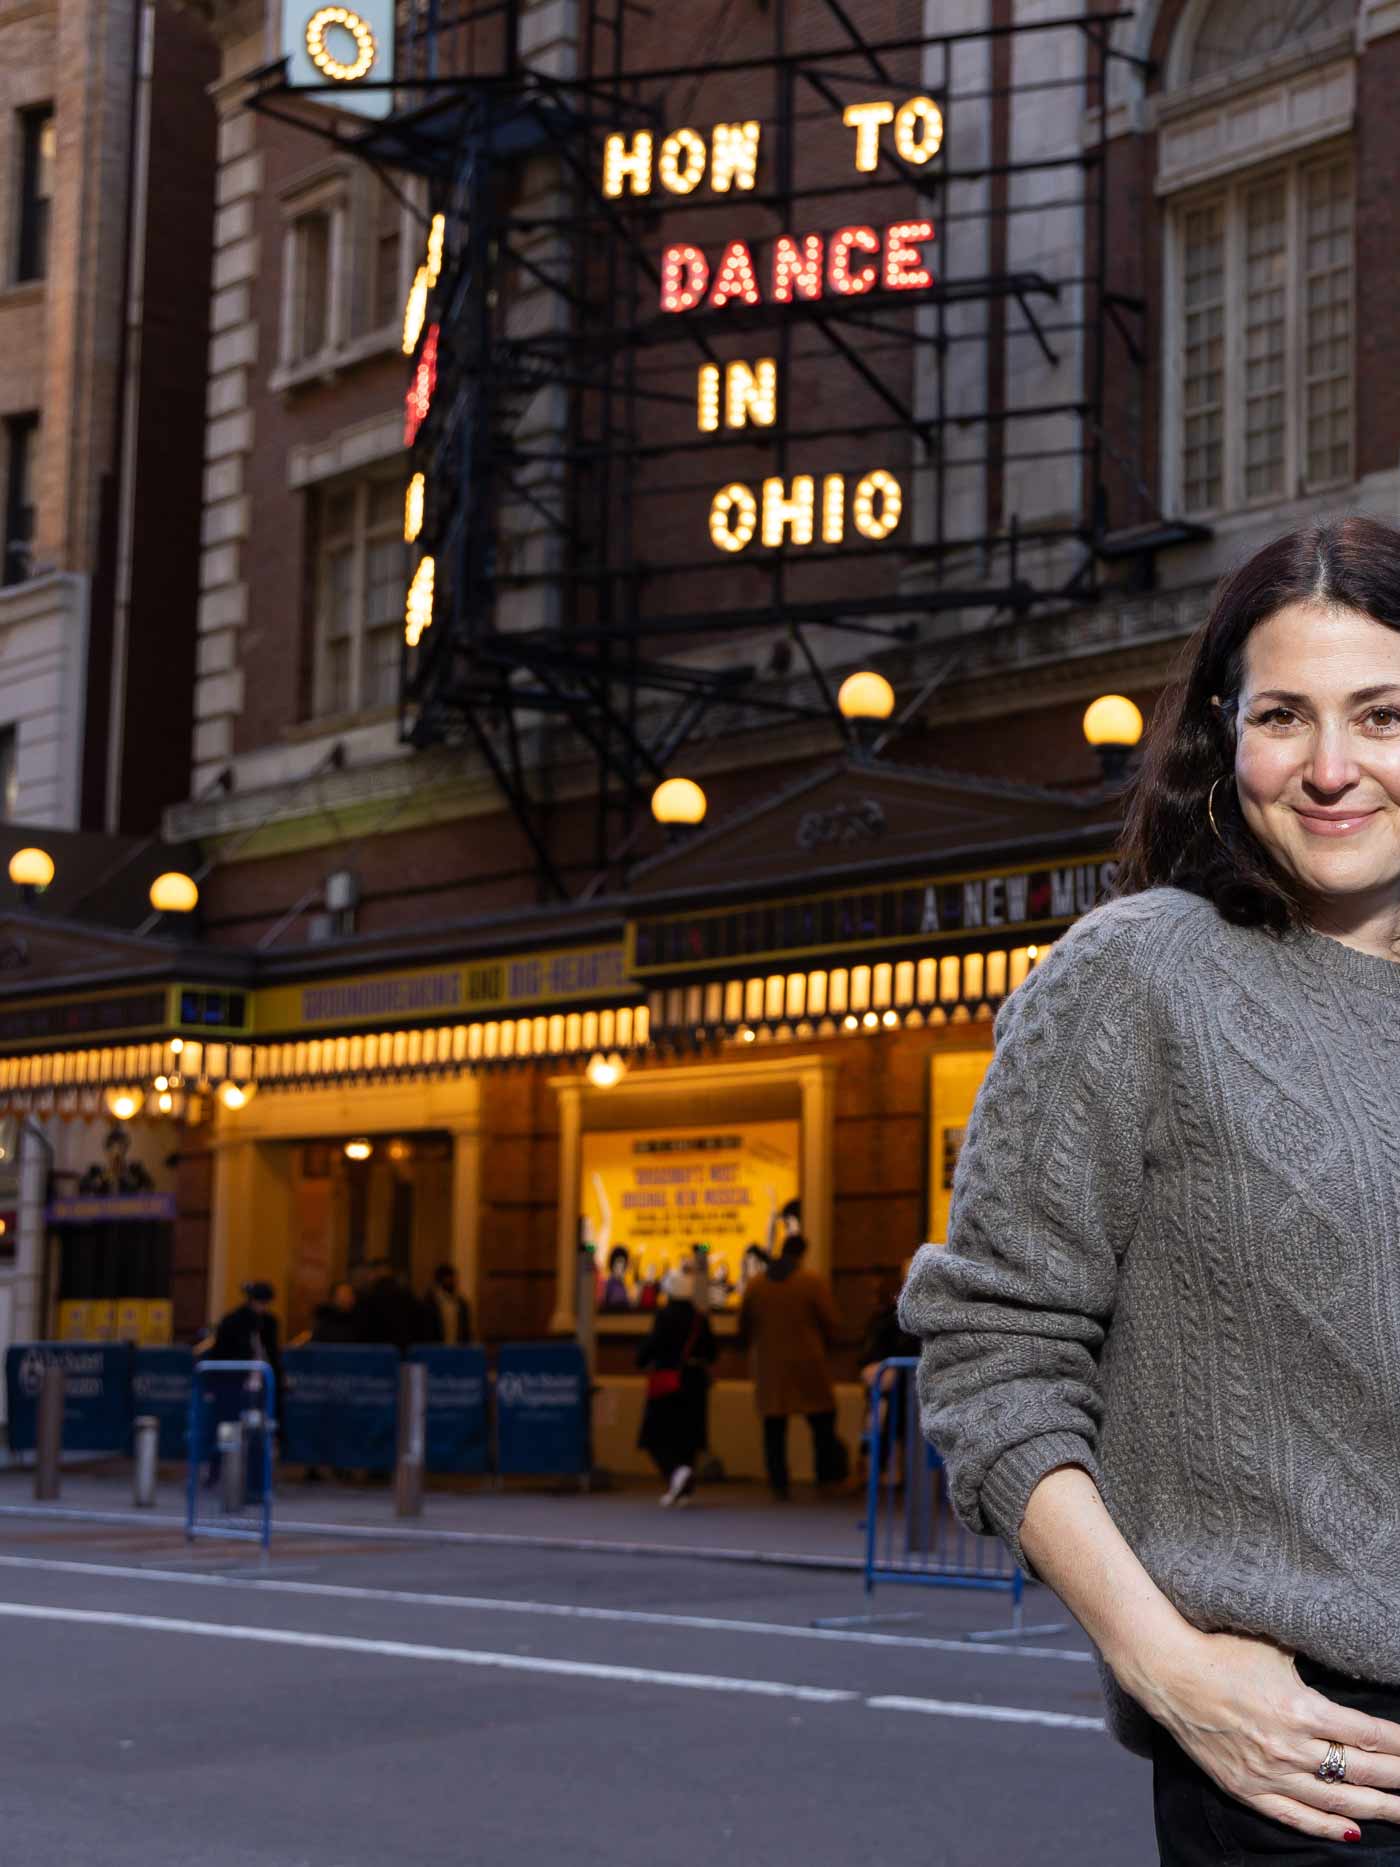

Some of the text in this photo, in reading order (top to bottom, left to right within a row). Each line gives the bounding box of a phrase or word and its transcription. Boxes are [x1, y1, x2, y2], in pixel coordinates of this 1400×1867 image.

[603, 96, 943, 198] HOW TO
[661, 219, 934, 313] DANCE
[698, 358, 776, 431] IN
[710, 469, 902, 552] OHIO
[920, 886, 940, 933] A
[963, 874, 1029, 927] NEW
